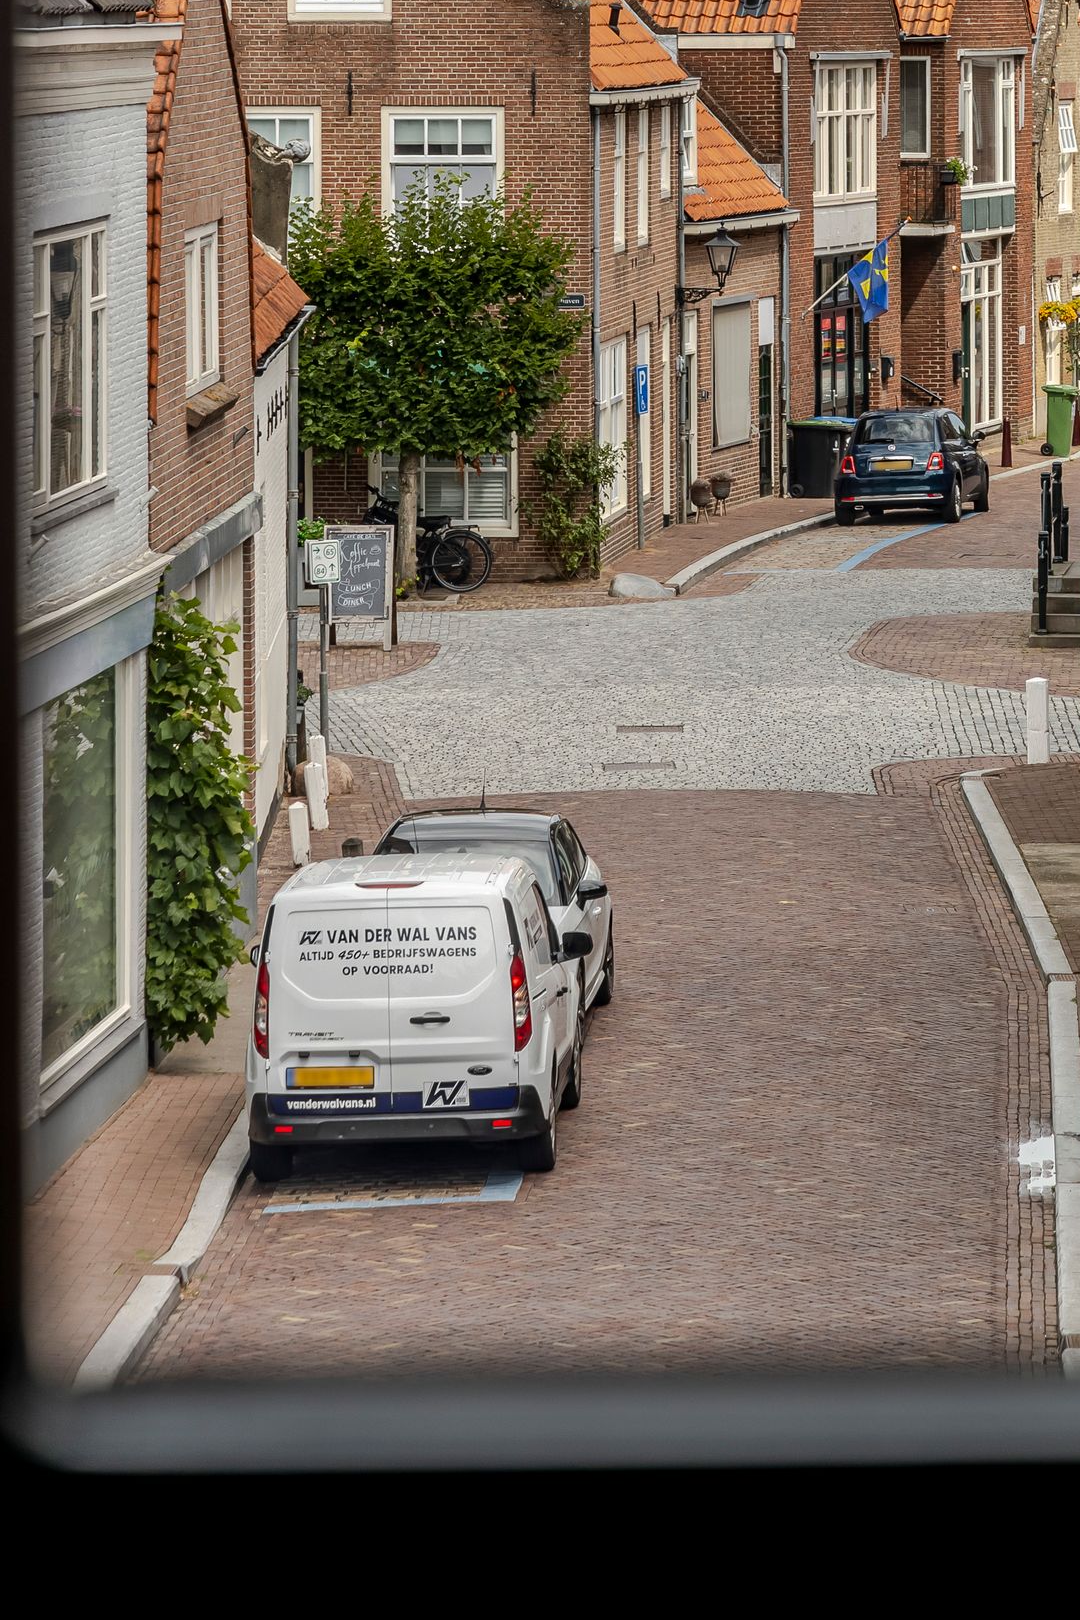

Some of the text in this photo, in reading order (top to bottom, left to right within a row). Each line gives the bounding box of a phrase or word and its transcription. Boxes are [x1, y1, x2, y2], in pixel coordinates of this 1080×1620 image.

[639, 370, 646, 395] P
[325, 548, 334, 556] 65
[316, 567, 325, 575] 84
[345, 582, 372, 592] LUNCH
[342, 597, 365, 606] DINER
[326, 930, 359, 944] VAN
[364, 929, 392, 943] DER
[396, 927, 430, 942] WAL
[435, 926, 477, 941] VANS
[299, 947, 477, 962] ALTIJD 450+ BEDRIJFSWAGENS
[342, 964, 434, 976] OP VOORRAAD!
[286, 1097, 377, 1110] vanderwalvans.nl
